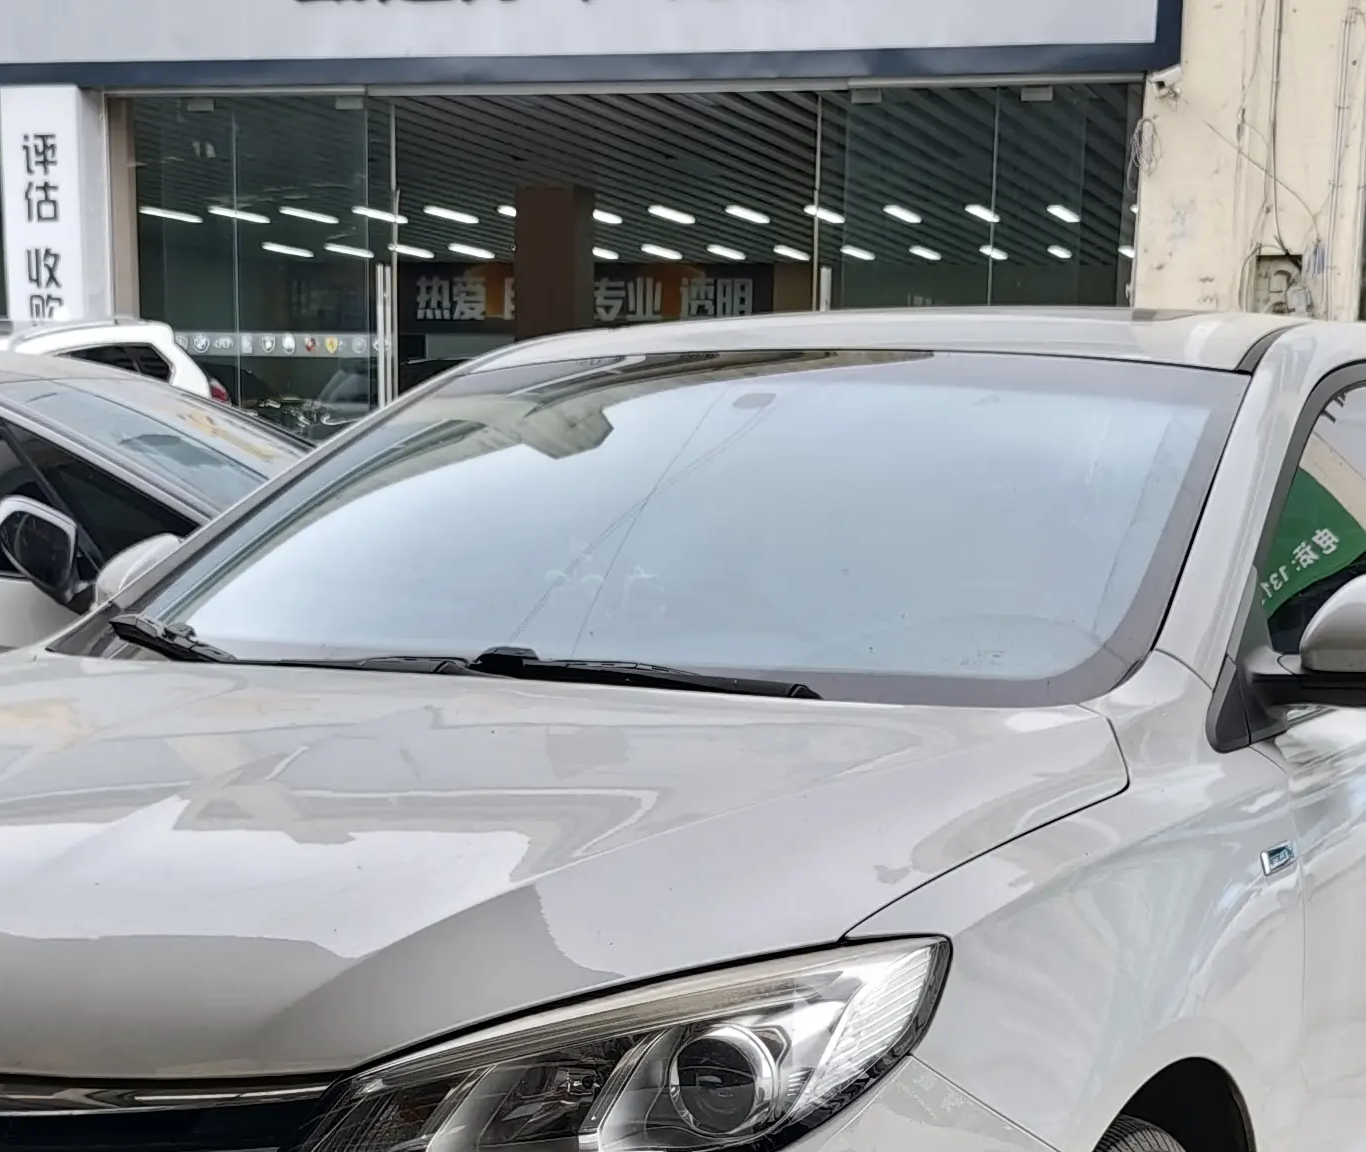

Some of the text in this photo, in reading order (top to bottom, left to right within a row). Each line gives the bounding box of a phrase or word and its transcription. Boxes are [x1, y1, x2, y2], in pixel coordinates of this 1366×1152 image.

[23, 133, 59, 222] 评估
[417, 276, 485, 321] 热爱
[594, 277, 662, 322] 专业
[679, 276, 753, 317] 透明
